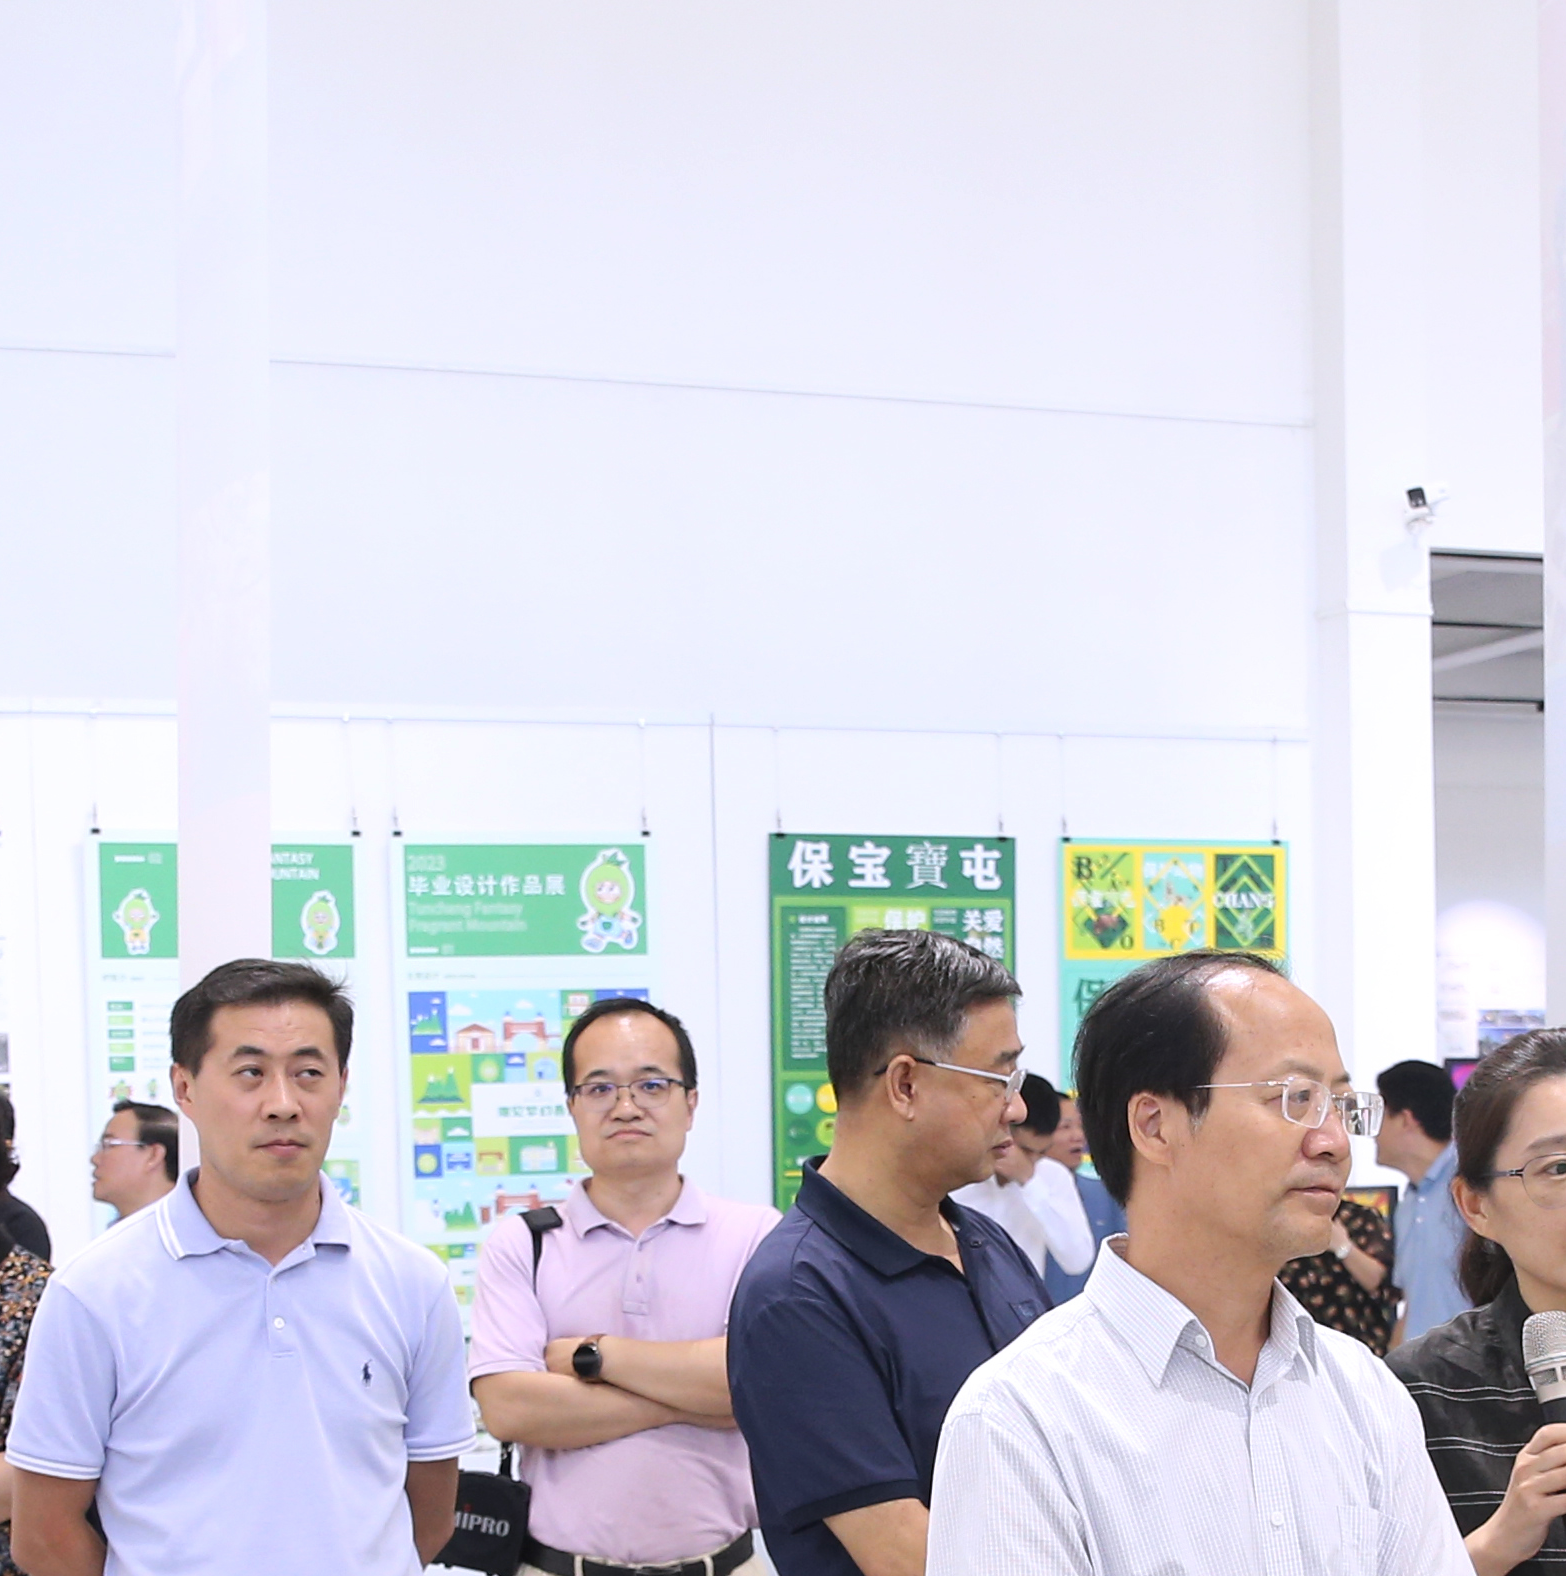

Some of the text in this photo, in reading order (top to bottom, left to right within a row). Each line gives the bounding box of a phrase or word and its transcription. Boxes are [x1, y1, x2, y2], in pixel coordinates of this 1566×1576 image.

[407, 874, 566, 897] 毕业设计作品展
